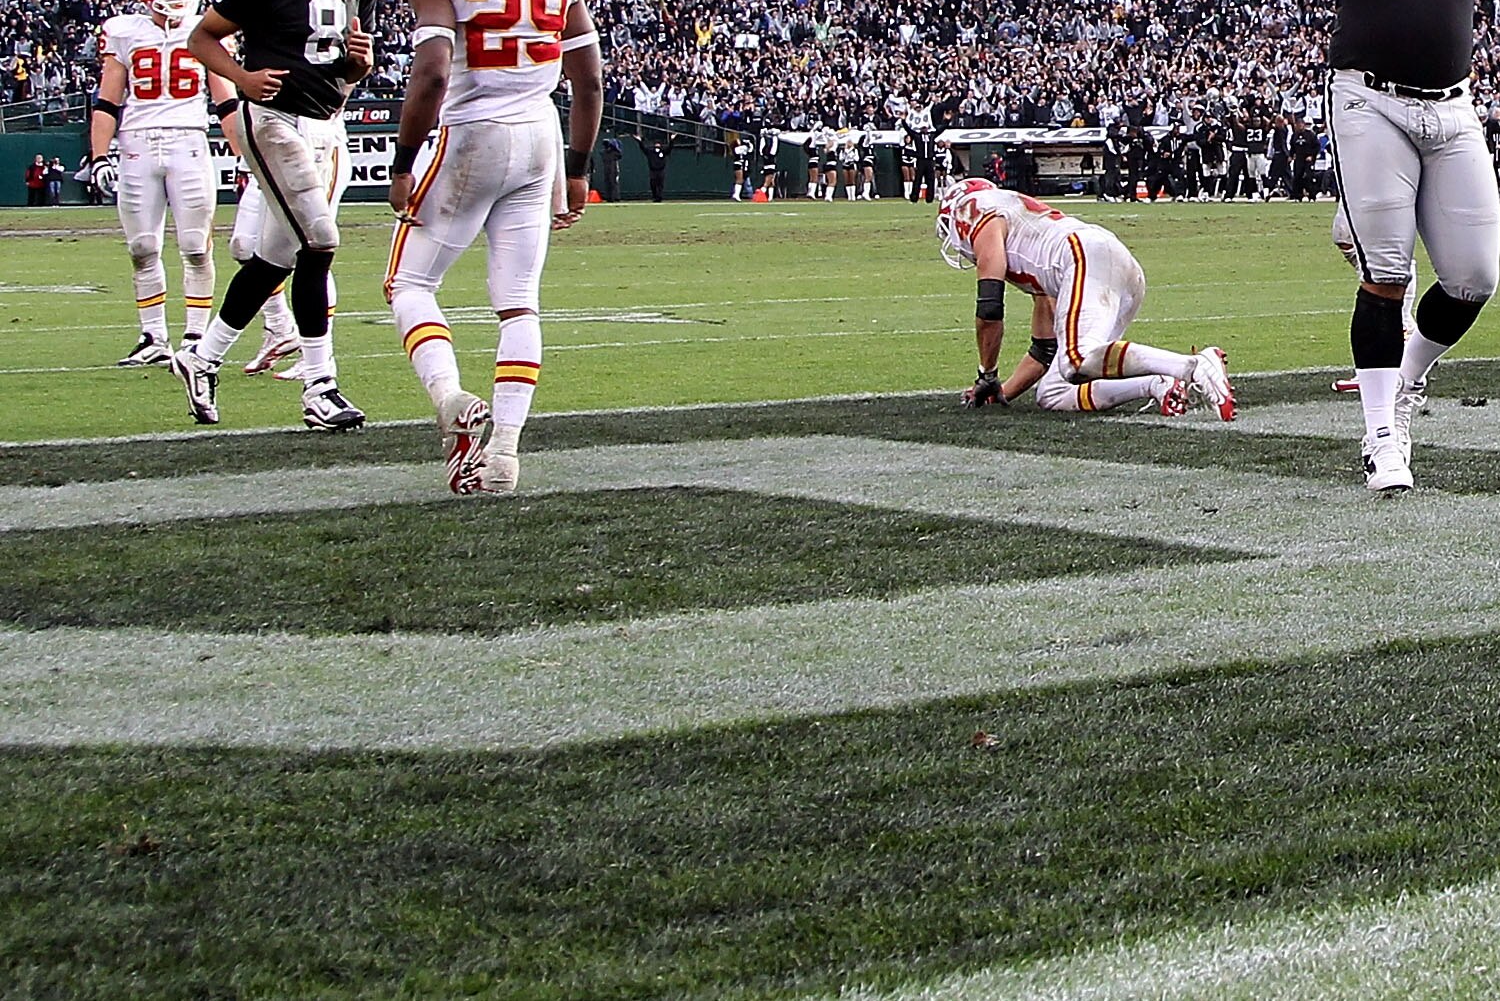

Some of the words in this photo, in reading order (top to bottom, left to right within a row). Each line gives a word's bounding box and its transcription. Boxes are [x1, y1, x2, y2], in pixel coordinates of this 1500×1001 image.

[131, 47, 199, 100] 96
[344, 108, 390, 123] erizon
[1247, 129, 1263, 141] 23
